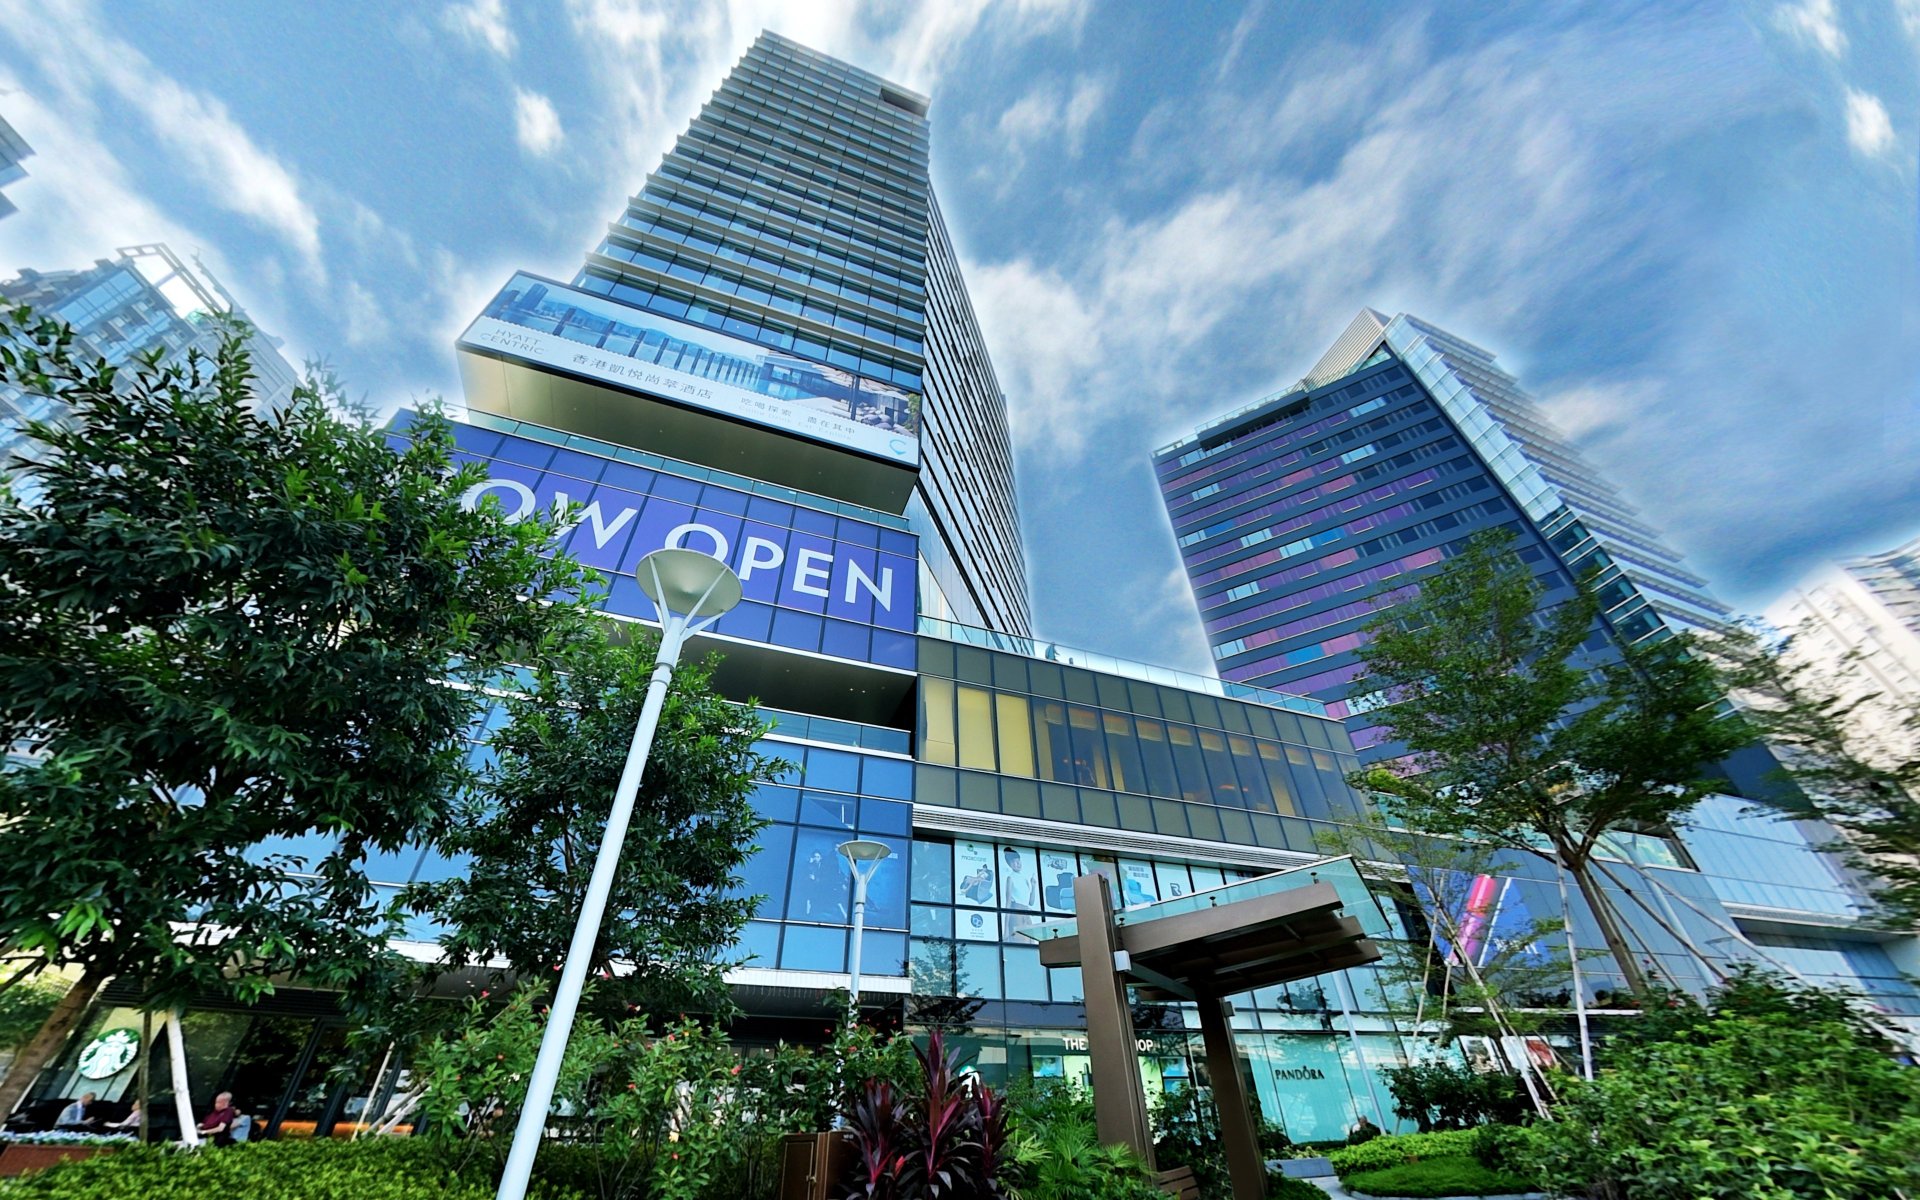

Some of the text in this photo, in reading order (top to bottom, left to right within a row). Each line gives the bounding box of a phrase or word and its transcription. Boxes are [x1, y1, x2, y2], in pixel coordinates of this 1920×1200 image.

[480, 332, 546, 355] CENTRIC
[494, 328, 542, 346] HYATT
[443, 467, 638, 550] OW
[1062, 1037, 1087, 1051] THE
[1274, 1064, 1325, 1080] PANDORA
